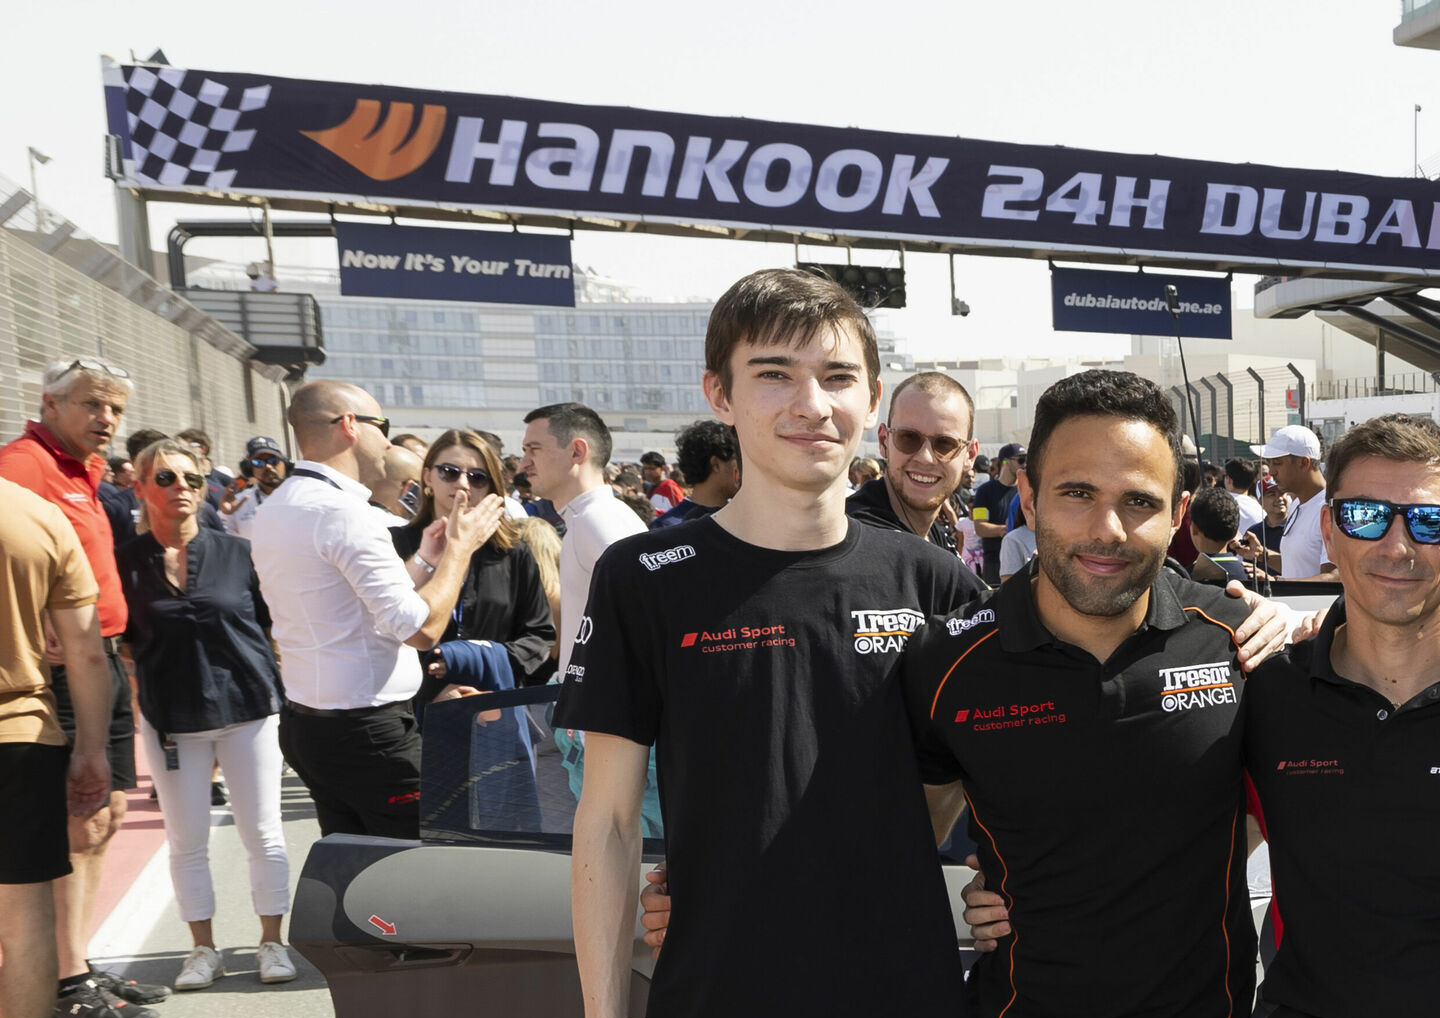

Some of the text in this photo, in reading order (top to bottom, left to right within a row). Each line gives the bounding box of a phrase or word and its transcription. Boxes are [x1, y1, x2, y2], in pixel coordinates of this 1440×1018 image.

[980, 164, 1172, 230] 24H
[342, 250, 572, 279] Now It's Your Turn
[639, 544, 696, 571] freem
[700, 624, 786, 642] Audi Sport
[946, 609, 995, 636] freem
[702, 637, 796, 653] customer racing
[1159, 661, 1231, 692] Tresor
[972, 700, 1055, 720] Audi Sport
[1161, 686, 1237, 713] ORANGE1
[973, 712, 1066, 732] customer racing
[1310, 760, 1338, 768] Sport
